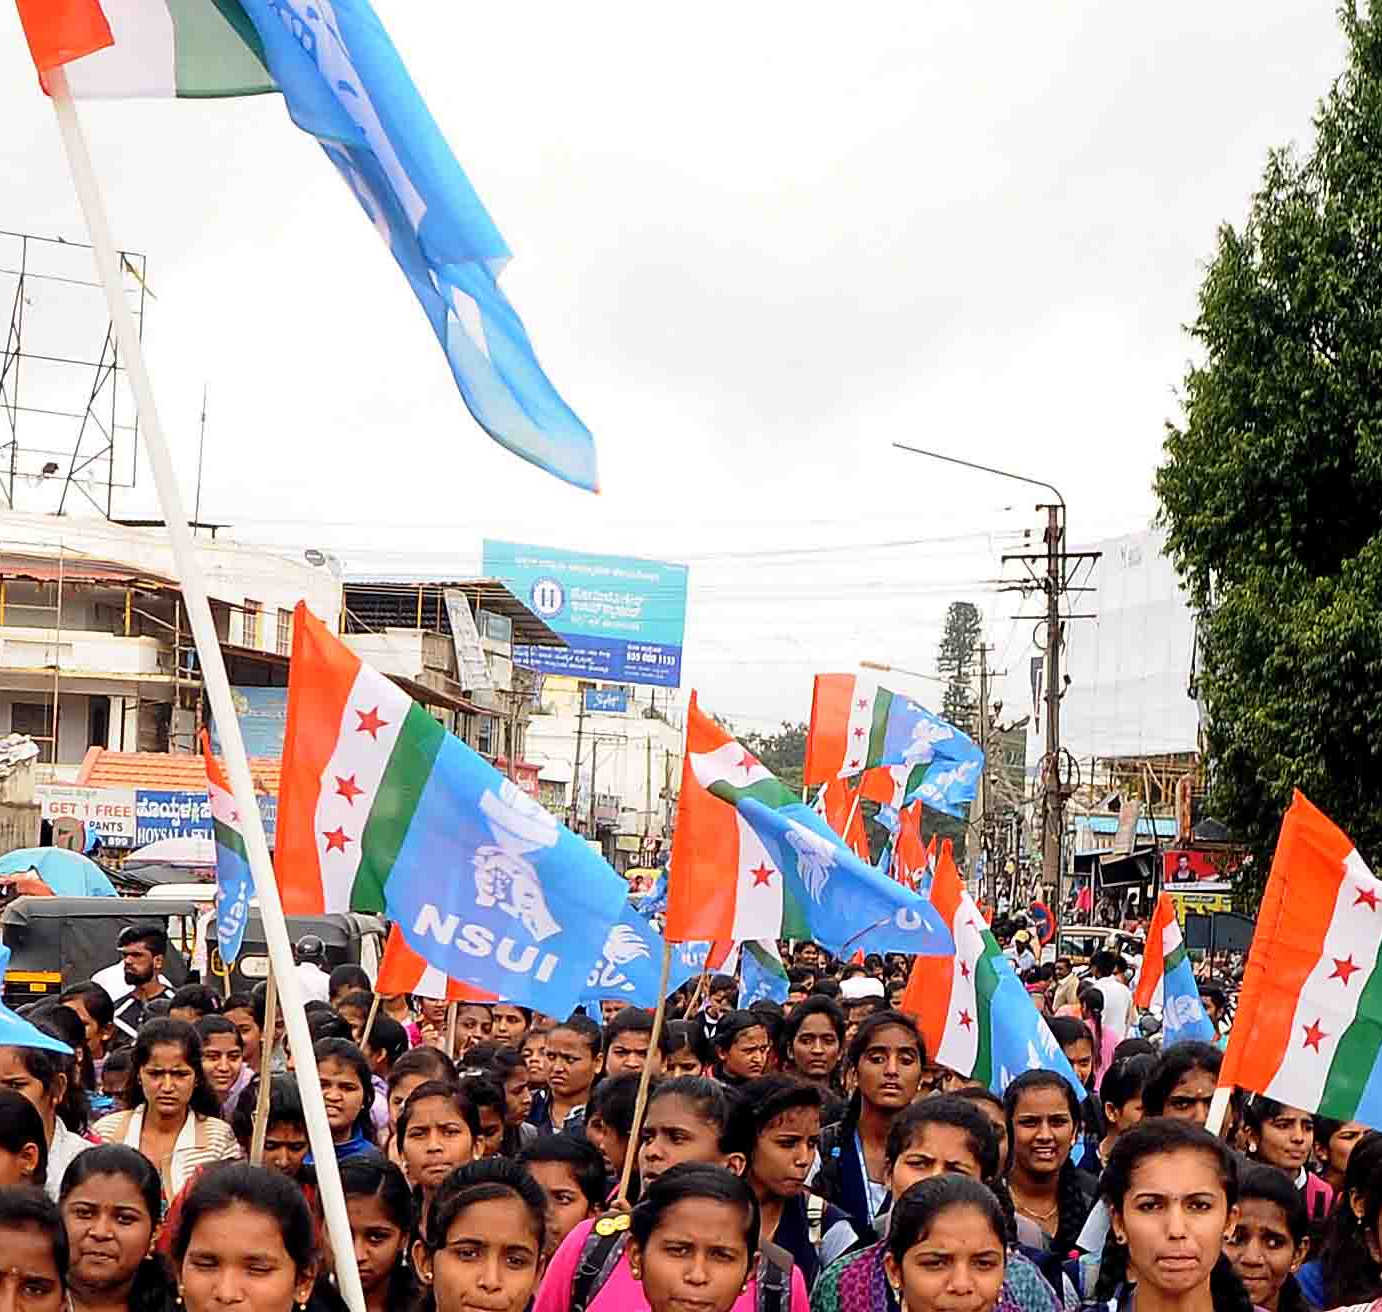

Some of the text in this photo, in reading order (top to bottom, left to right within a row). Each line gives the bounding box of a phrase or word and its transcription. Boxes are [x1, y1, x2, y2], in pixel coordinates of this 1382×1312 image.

[50, 802, 131, 818] GET 1 FREE
[89, 819, 123, 833] PANTS
[412, 903, 559, 983] NSUI
